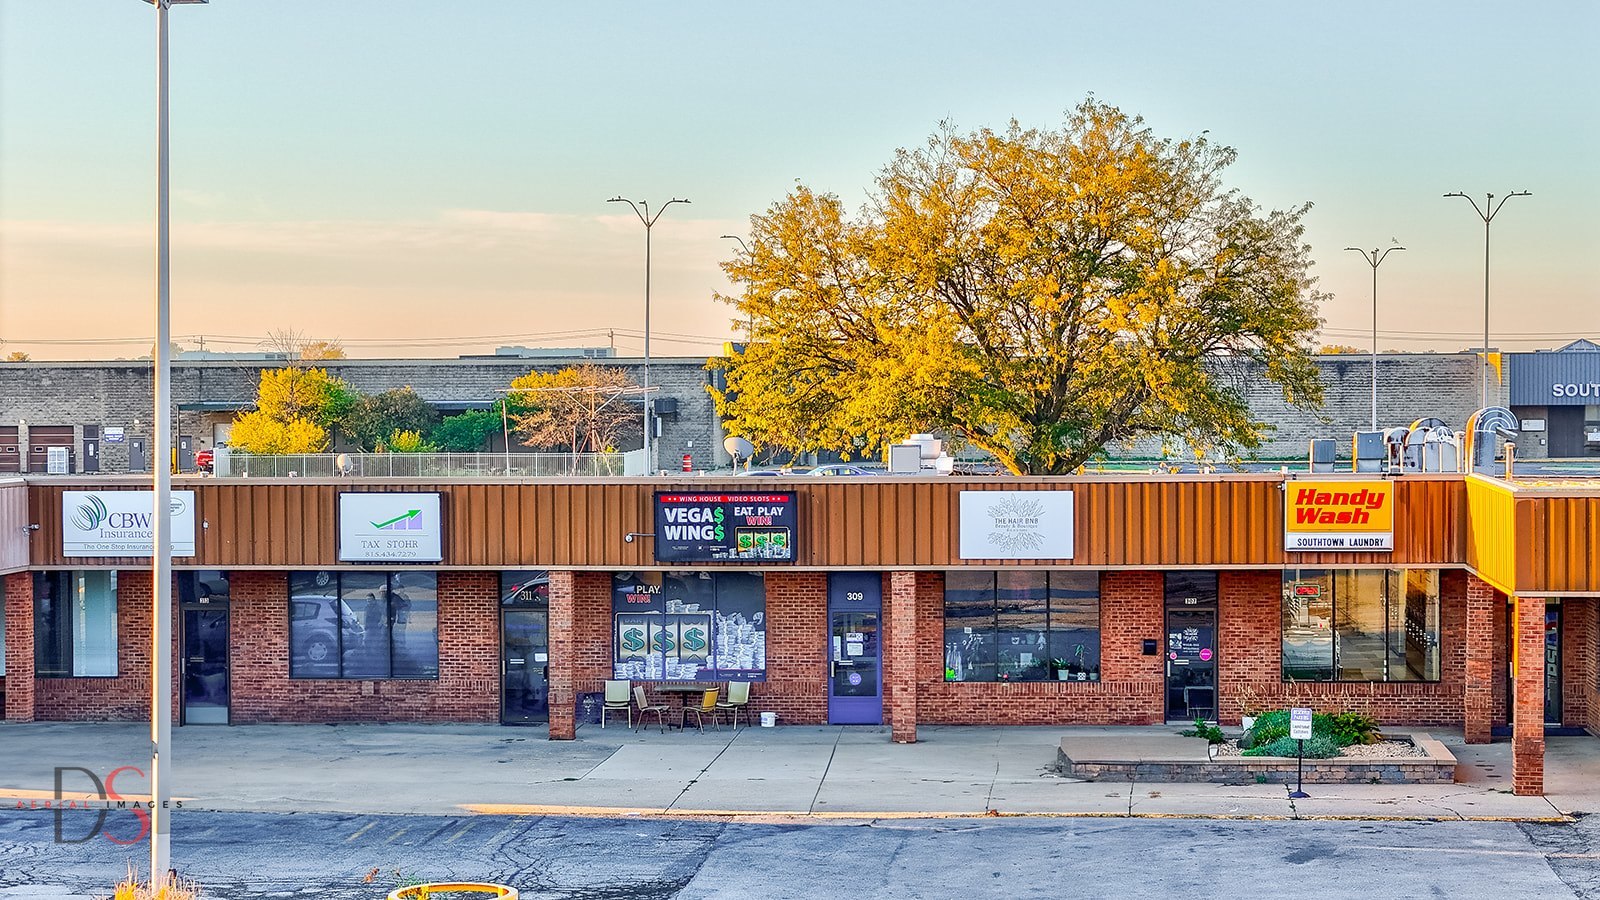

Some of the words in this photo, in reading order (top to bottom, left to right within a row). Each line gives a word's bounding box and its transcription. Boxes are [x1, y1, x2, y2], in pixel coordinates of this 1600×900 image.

[1295, 488, 1386, 510] Handy
[664, 507, 724, 524] VEGA$
[758, 506, 784, 516] PLAY
[1296, 507, 1370, 524] Wash
[108, 512, 152, 528] CBW
[746, 516, 772, 526] WIN!
[100, 528, 153, 539] Insurance
[664, 525, 725, 541] WING$
[111, 543, 126, 551] Stop
[361, 540, 380, 549] TAX
[386, 540, 419, 549] STOHR
[1297, 538, 1345, 547] SOUTHTOWN
[1349, 538, 1384, 547] LAUNDRY
[636, 585, 661, 594] PLAY.
[1296, 586, 1319, 596] OPEN
[520, 590, 533, 601] 311
[846, 592, 864, 601] 309
